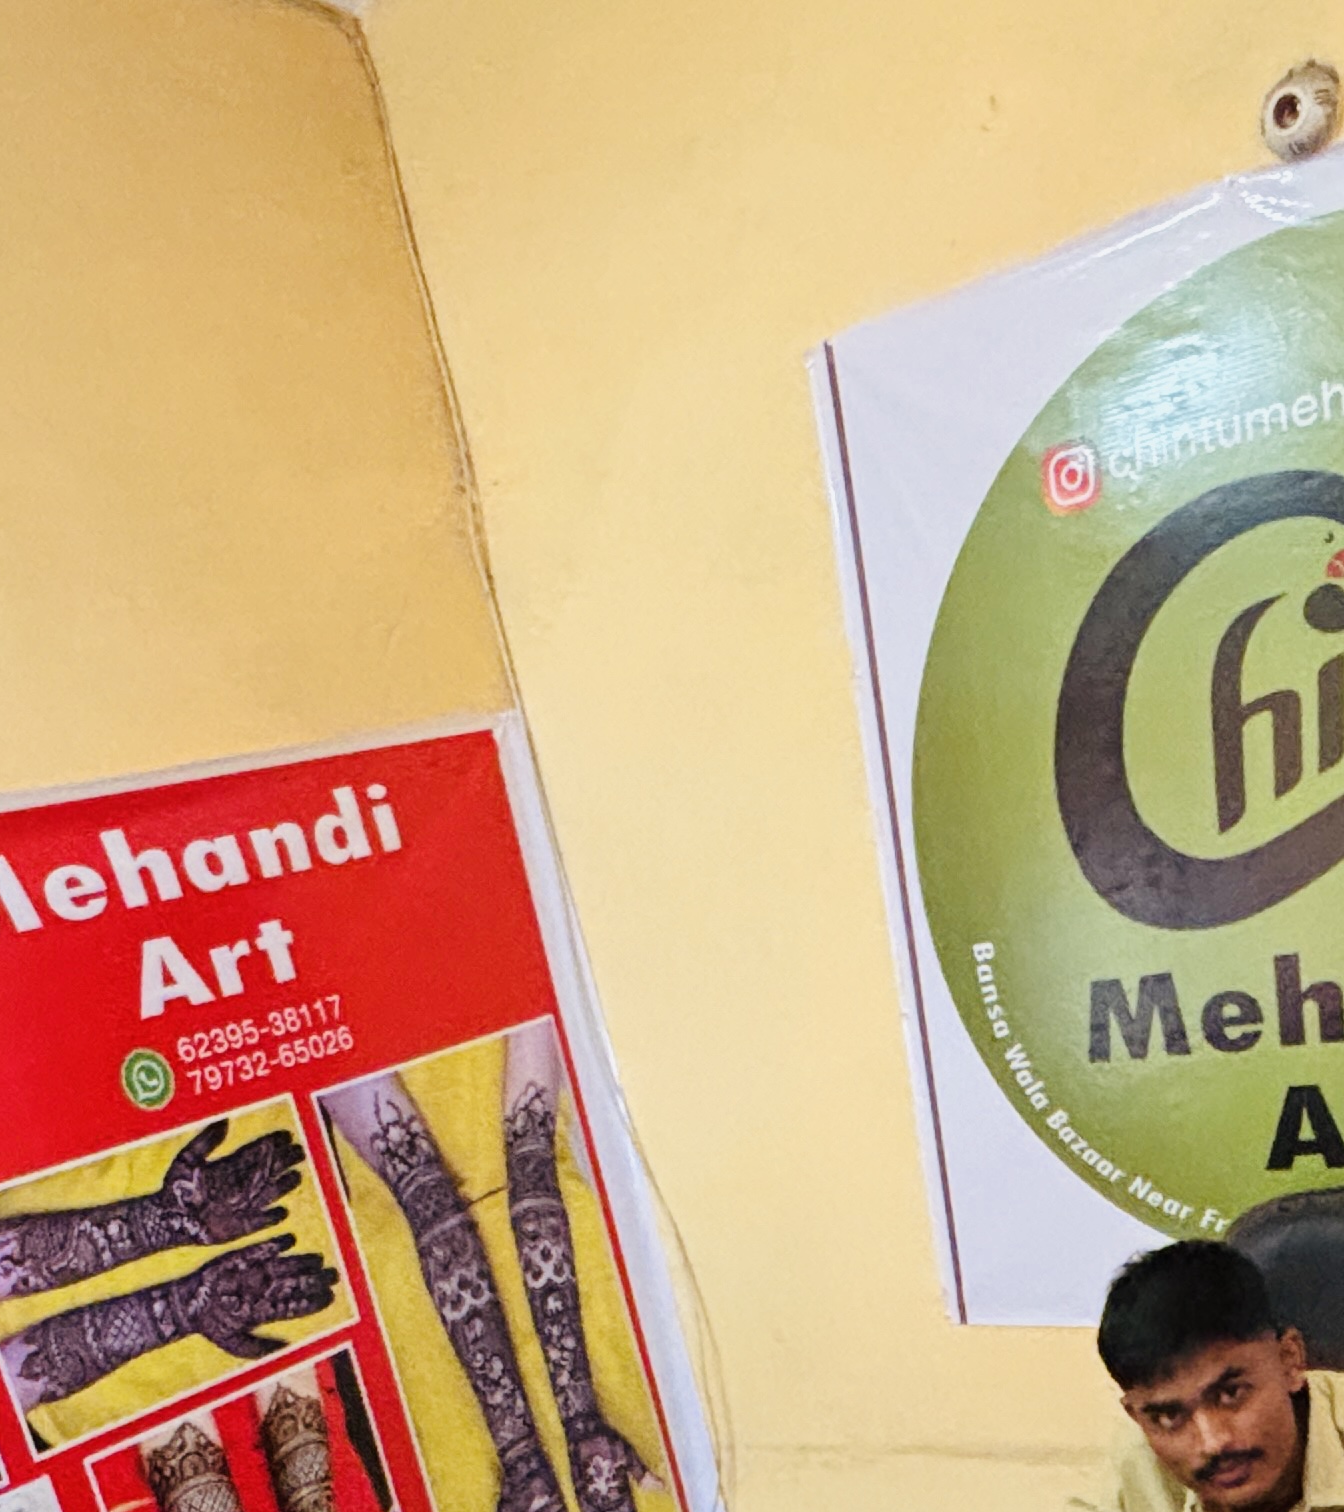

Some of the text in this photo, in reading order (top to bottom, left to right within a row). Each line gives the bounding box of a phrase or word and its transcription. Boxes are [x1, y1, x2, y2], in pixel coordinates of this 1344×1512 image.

[139, 919, 295, 1020] Art
[176, 995, 343, 1064] 62395-38117
[186, 1026, 355, 1096] 79732-65026
[972, 942, 1010, 1039] Bansa
[1004, 1042, 1050, 1112] Wala
[1045, 1109, 1126, 1183] Bazaar
[1128, 1175, 1194, 1221] Near
